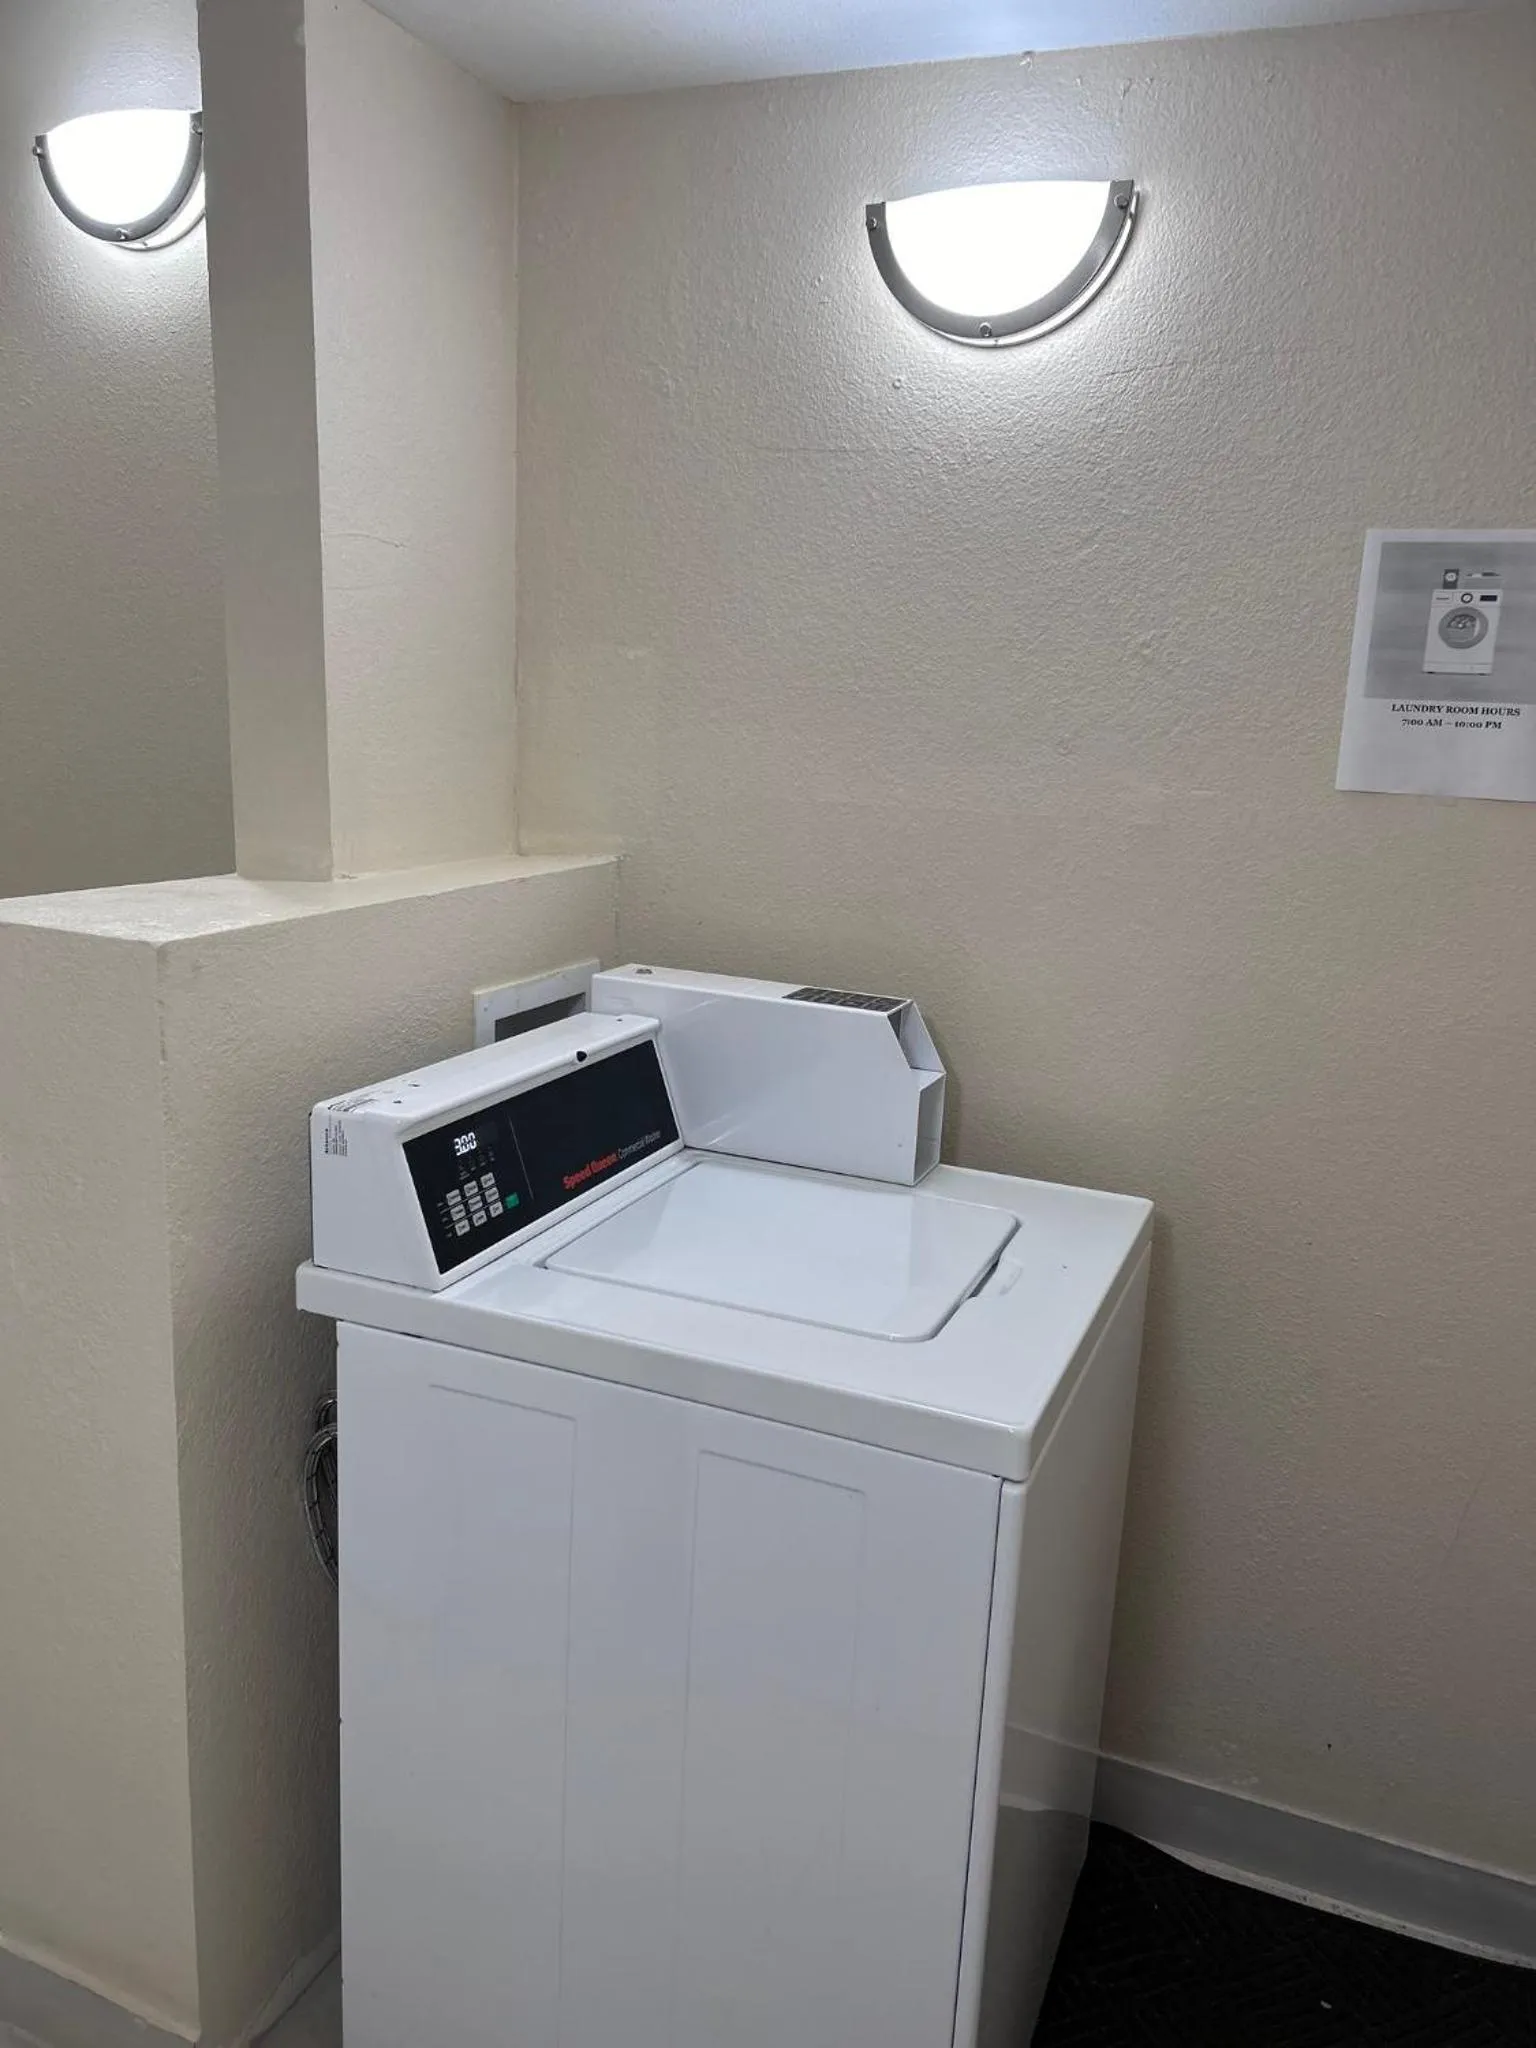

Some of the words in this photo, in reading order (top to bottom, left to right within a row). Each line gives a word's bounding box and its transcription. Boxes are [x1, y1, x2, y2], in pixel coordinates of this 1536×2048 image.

[1391, 703, 1444, 714] LAUNDRY
[1445, 705, 1479, 715] ROOM
[1481, 706, 1521, 717] HOURS
[1401, 719, 1424, 727] 7:00
[1425, 719, 1443, 727] AM
[1454, 721, 1483, 729] 10:00
[1484, 721, 1502, 730] PM
[563, 1164, 592, 1190] Speed
